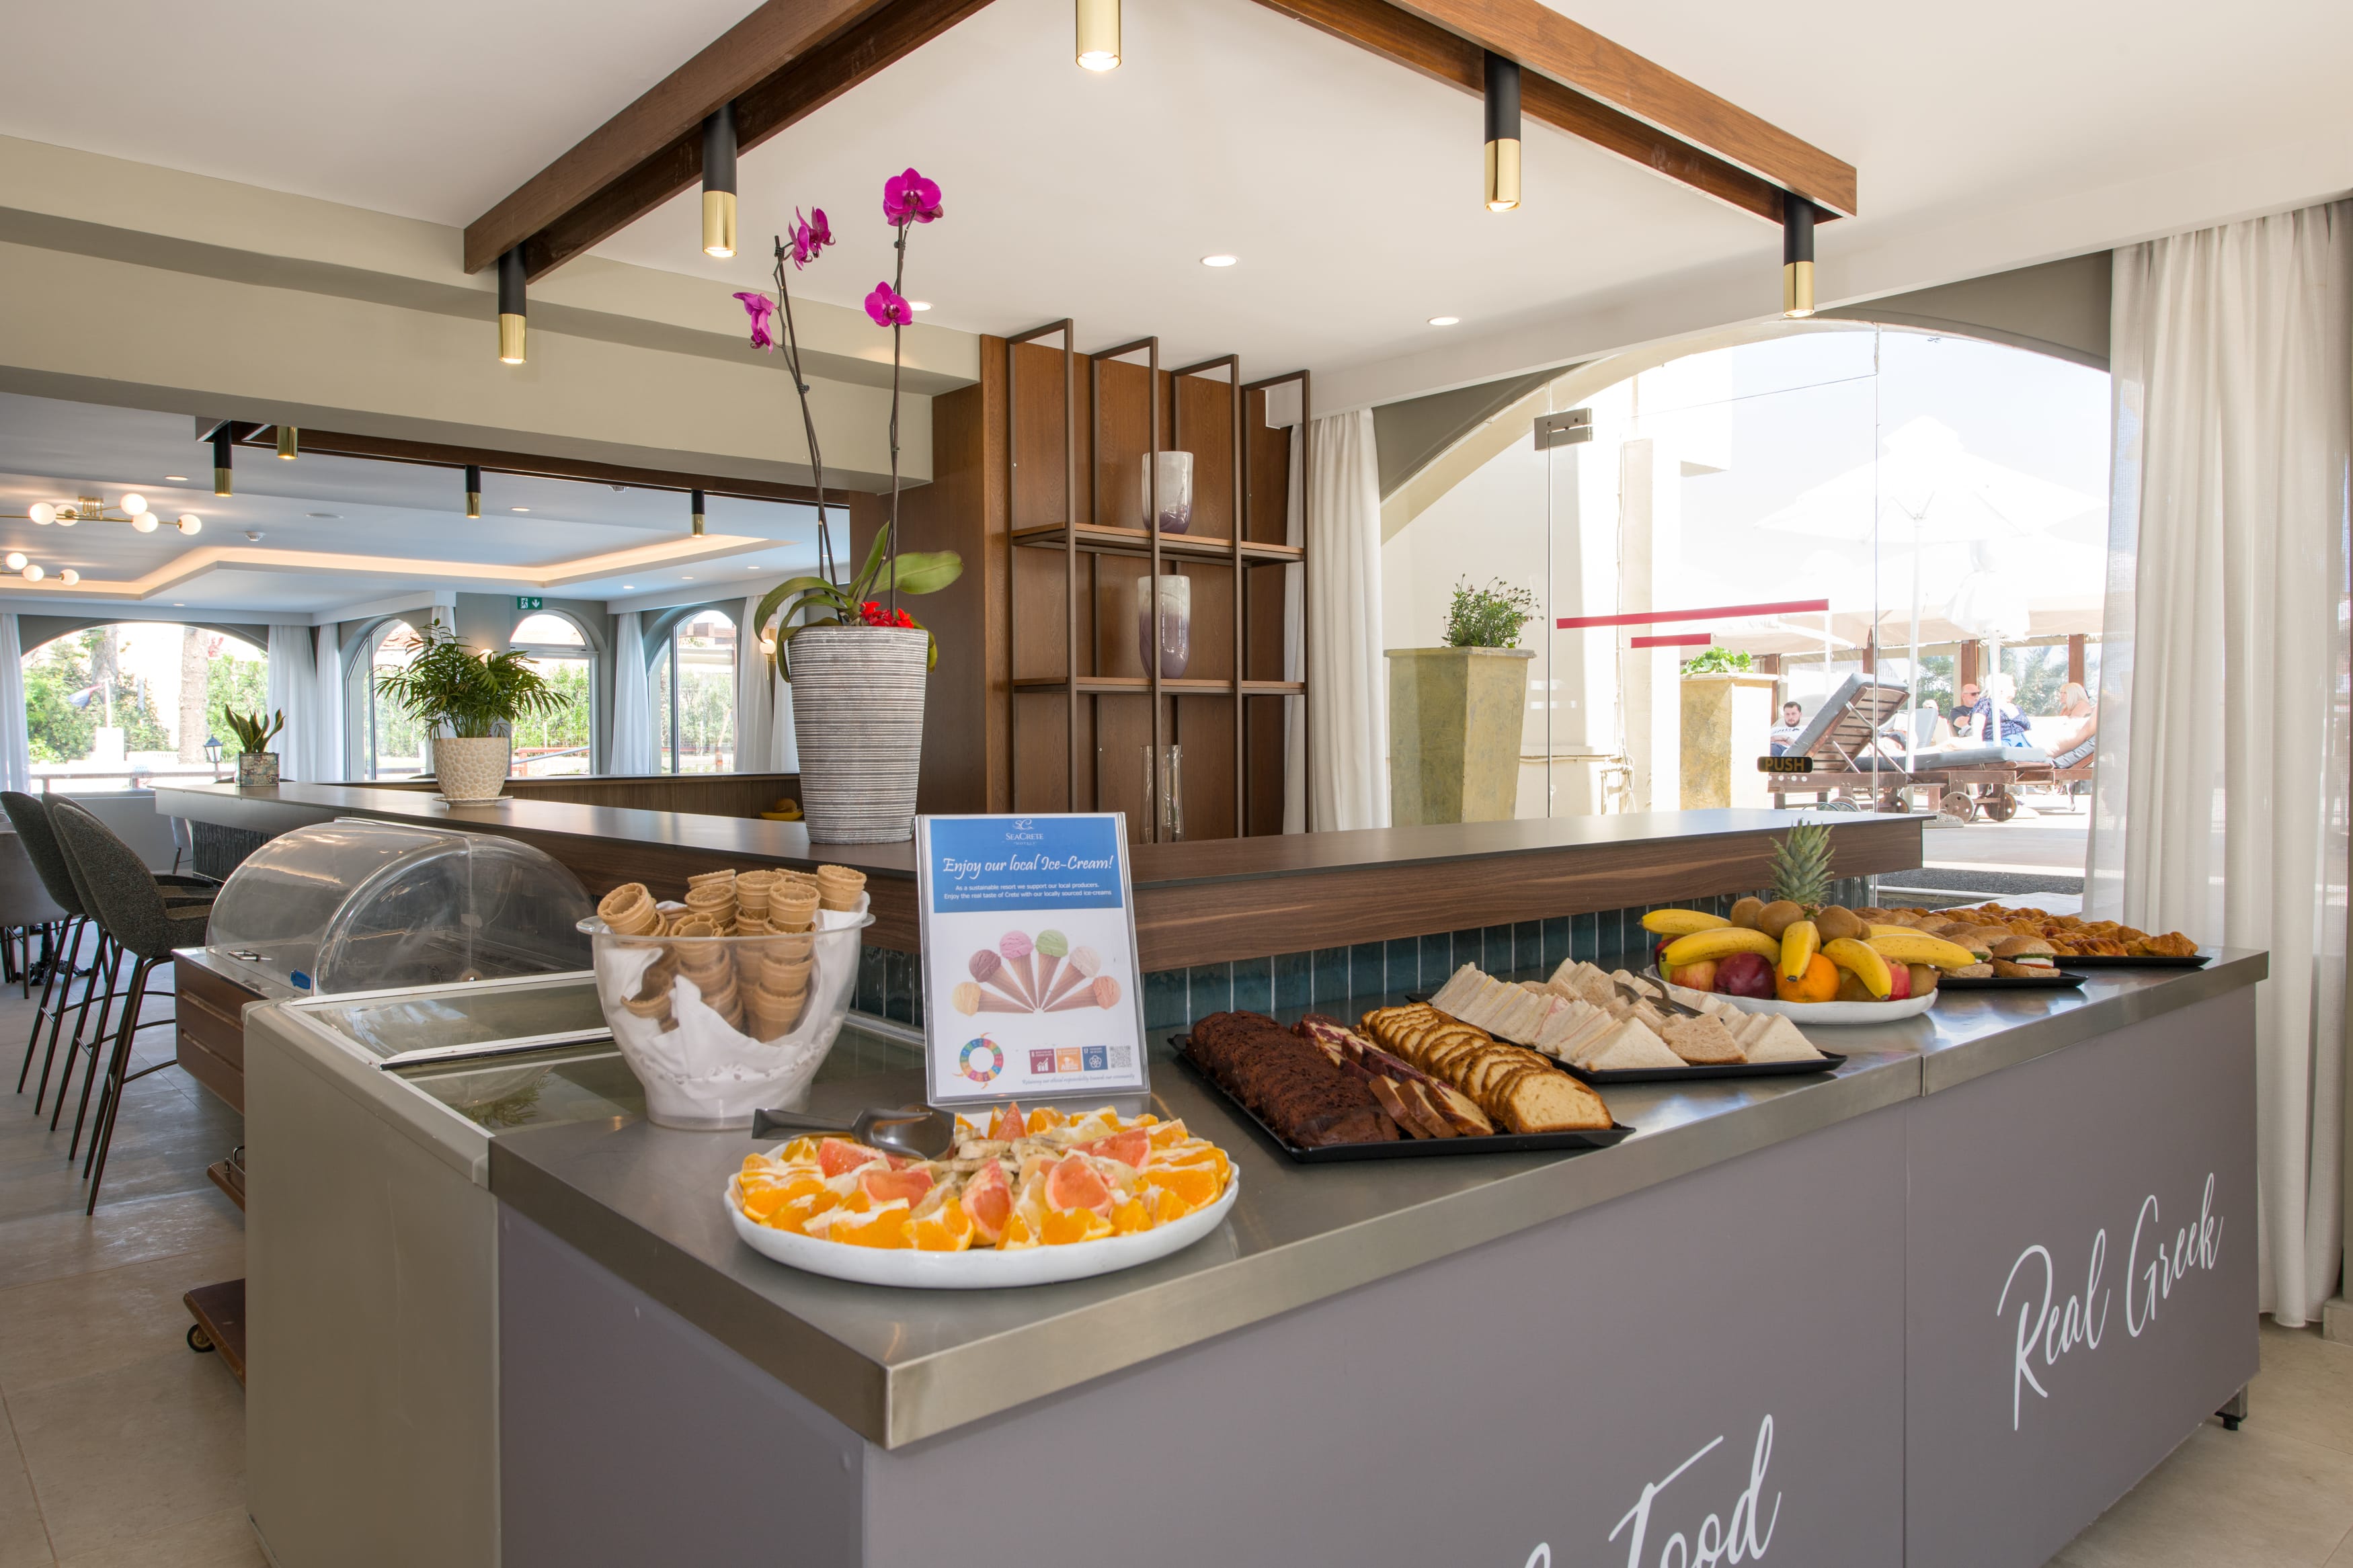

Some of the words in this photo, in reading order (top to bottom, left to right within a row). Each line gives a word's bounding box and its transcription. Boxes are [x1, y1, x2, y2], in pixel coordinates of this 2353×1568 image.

[1765, 757, 1805, 772] PUSH
[943, 858, 982, 880] Enjoy
[985, 862, 1007, 871] our
[1010, 854, 1041, 871] local
[1041, 854, 1114, 870] Ice-Cream!
[1027, 882, 1047, 891] support
[1043, 889, 1060, 897] locally
[1996, 1228, 2110, 1432] Real
[2126, 1172, 2224, 1338] Greek
